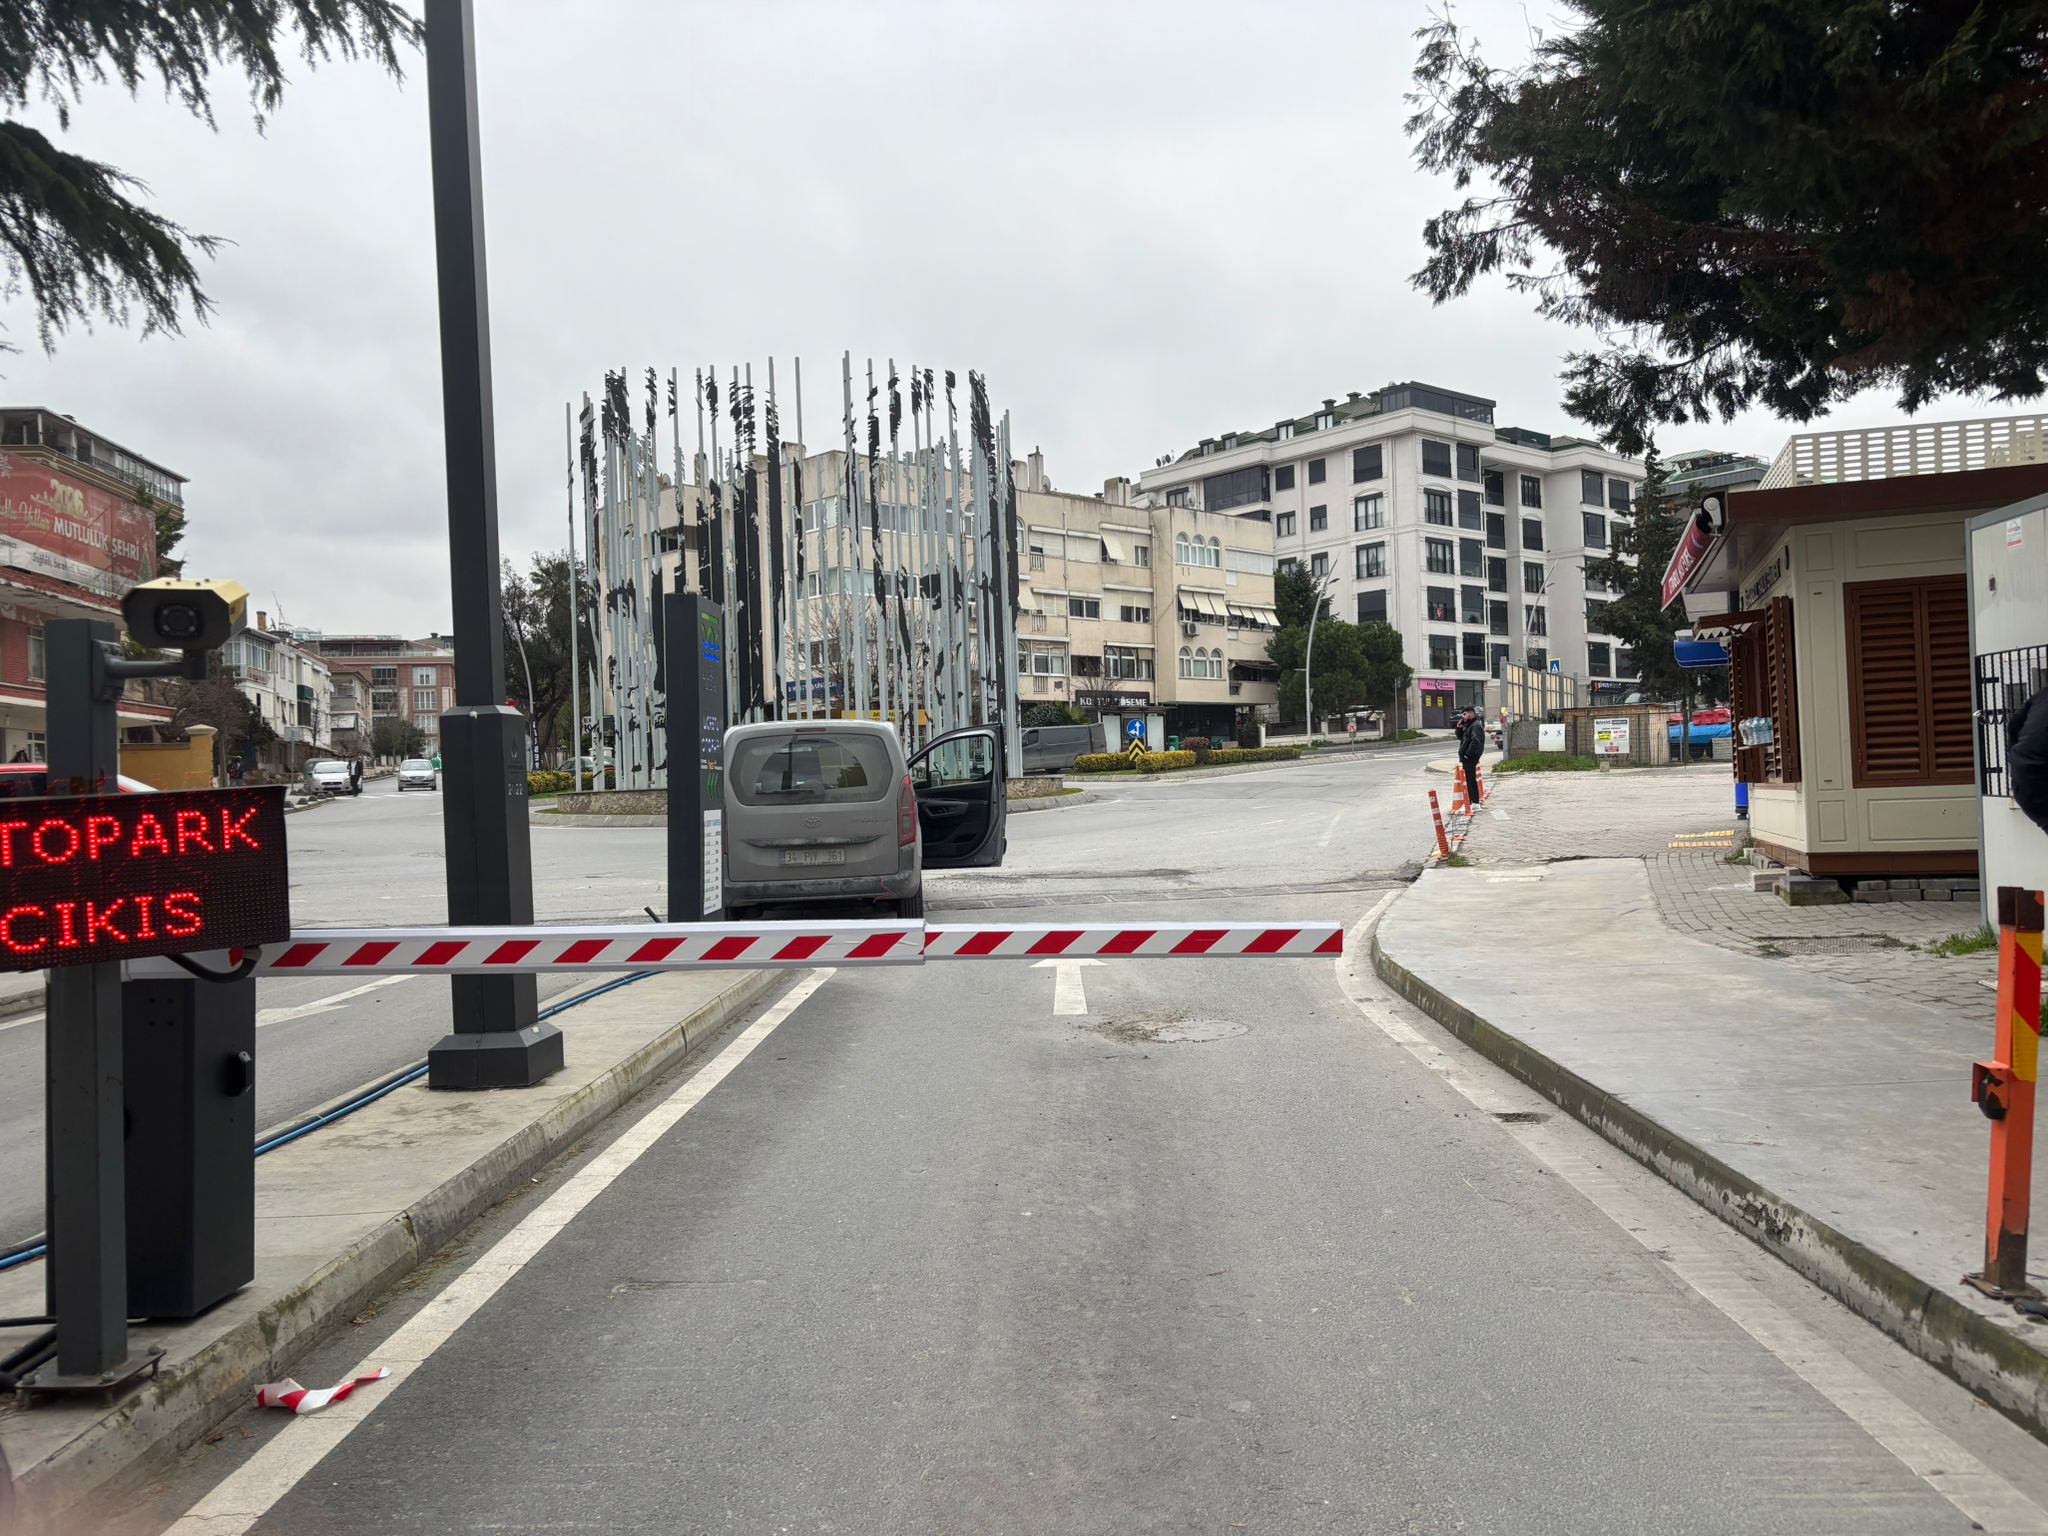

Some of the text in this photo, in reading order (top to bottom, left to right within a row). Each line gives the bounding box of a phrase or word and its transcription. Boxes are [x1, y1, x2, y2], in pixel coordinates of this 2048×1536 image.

[54, 516, 140, 561] MUTLULUK ŞEHRİ
[0, 807, 262, 867] TOPARK
[786, 851, 797, 862] 34
[0, 891, 204, 953] CIKIS
